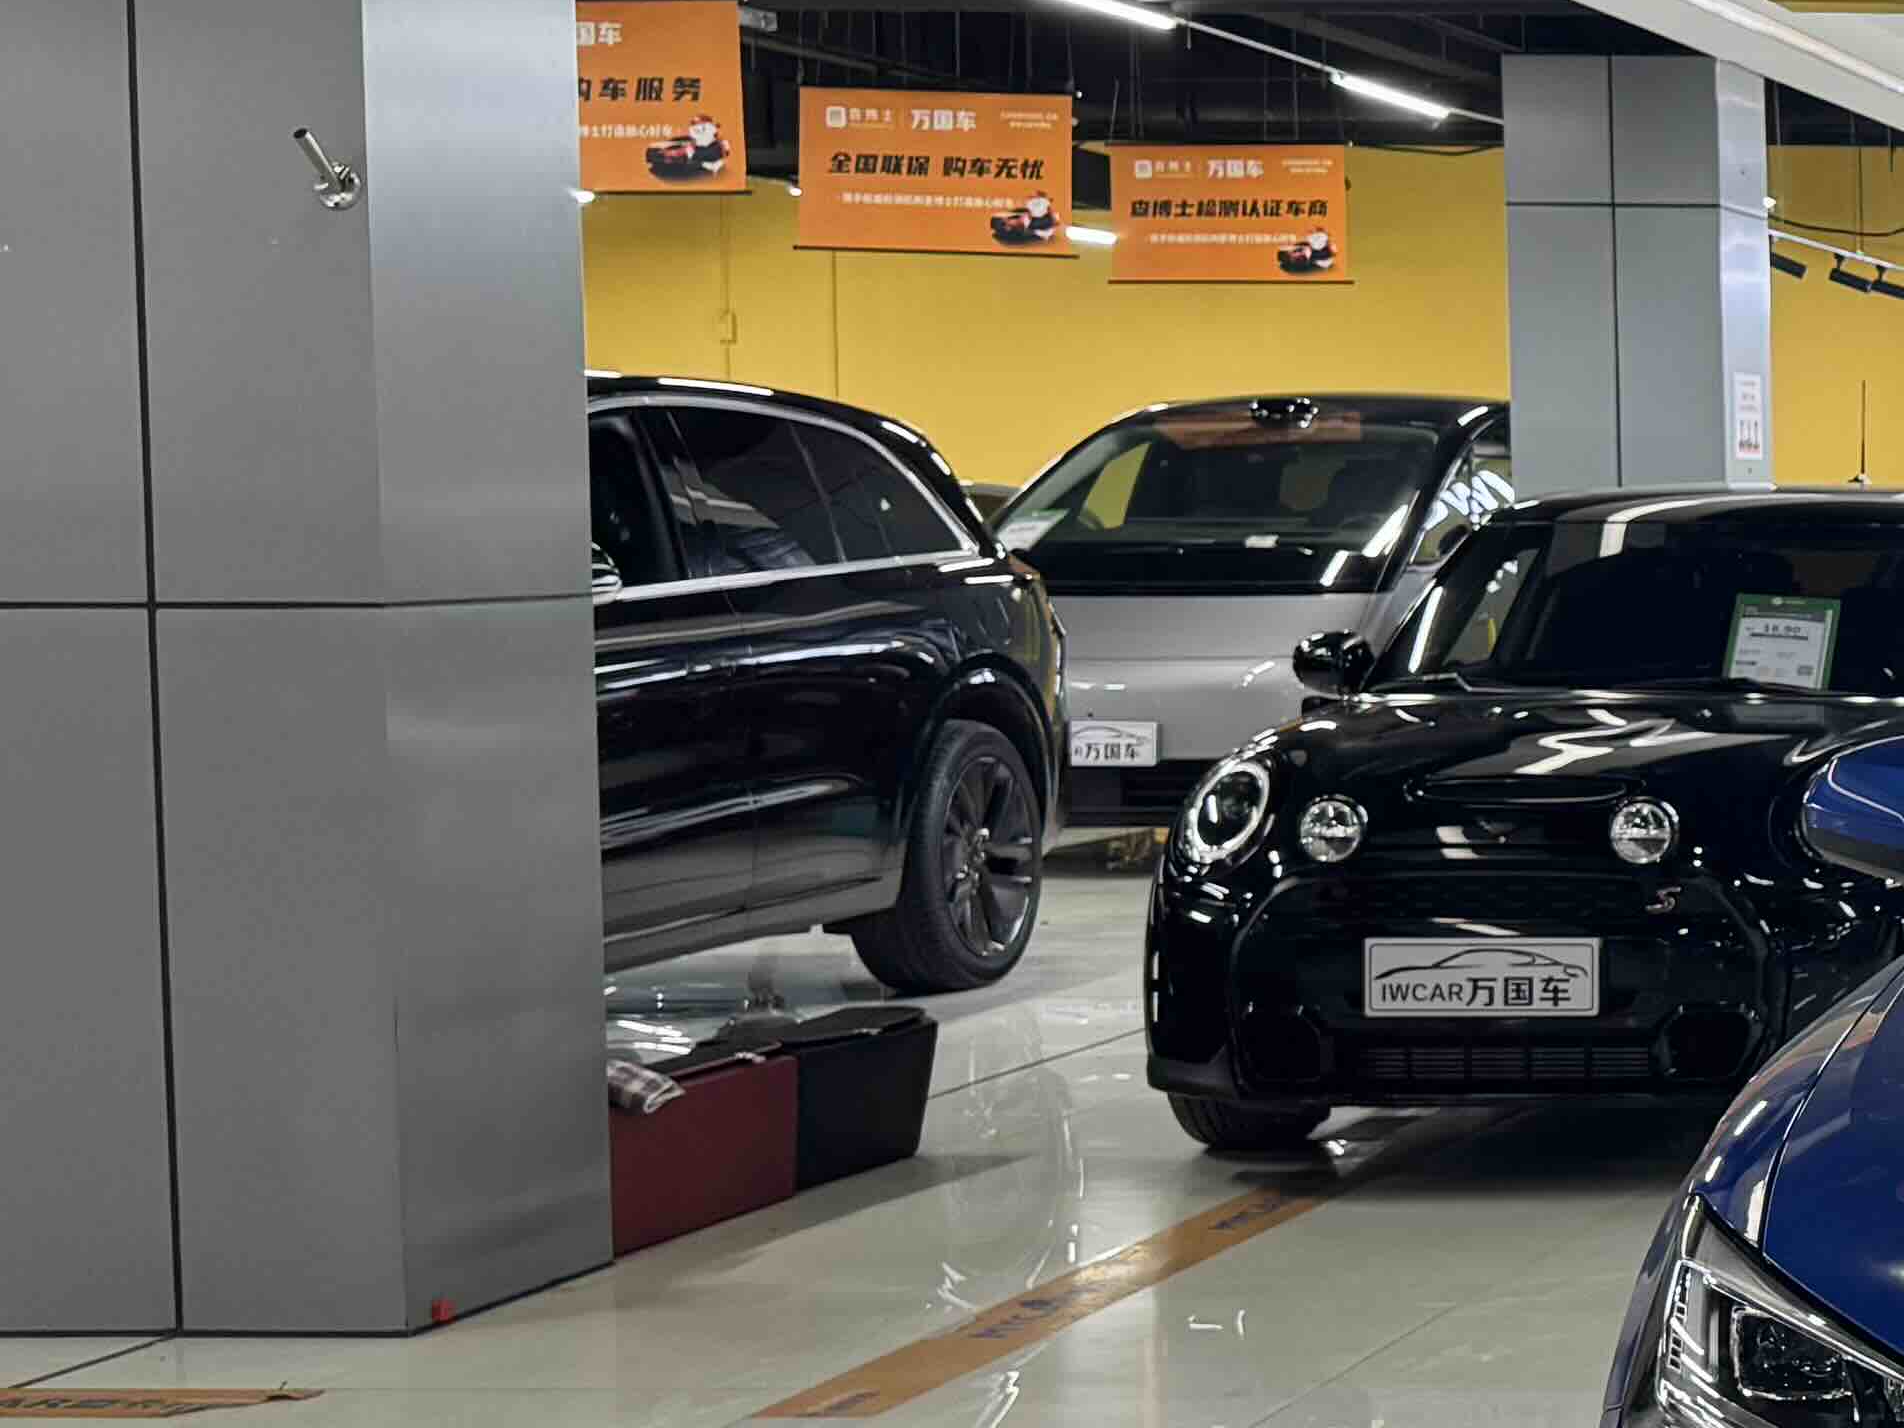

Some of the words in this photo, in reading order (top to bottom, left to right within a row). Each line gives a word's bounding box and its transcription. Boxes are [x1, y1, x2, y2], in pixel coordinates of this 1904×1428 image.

[911, 108, 977, 132] 万国车
[829, 151, 931, 177] 全国联保
[942, 155, 1045, 181] 购车无忧
[1207, 158, 1265, 180] 万国车
[1130, 198, 1329, 219] 查博士检测认证车商
